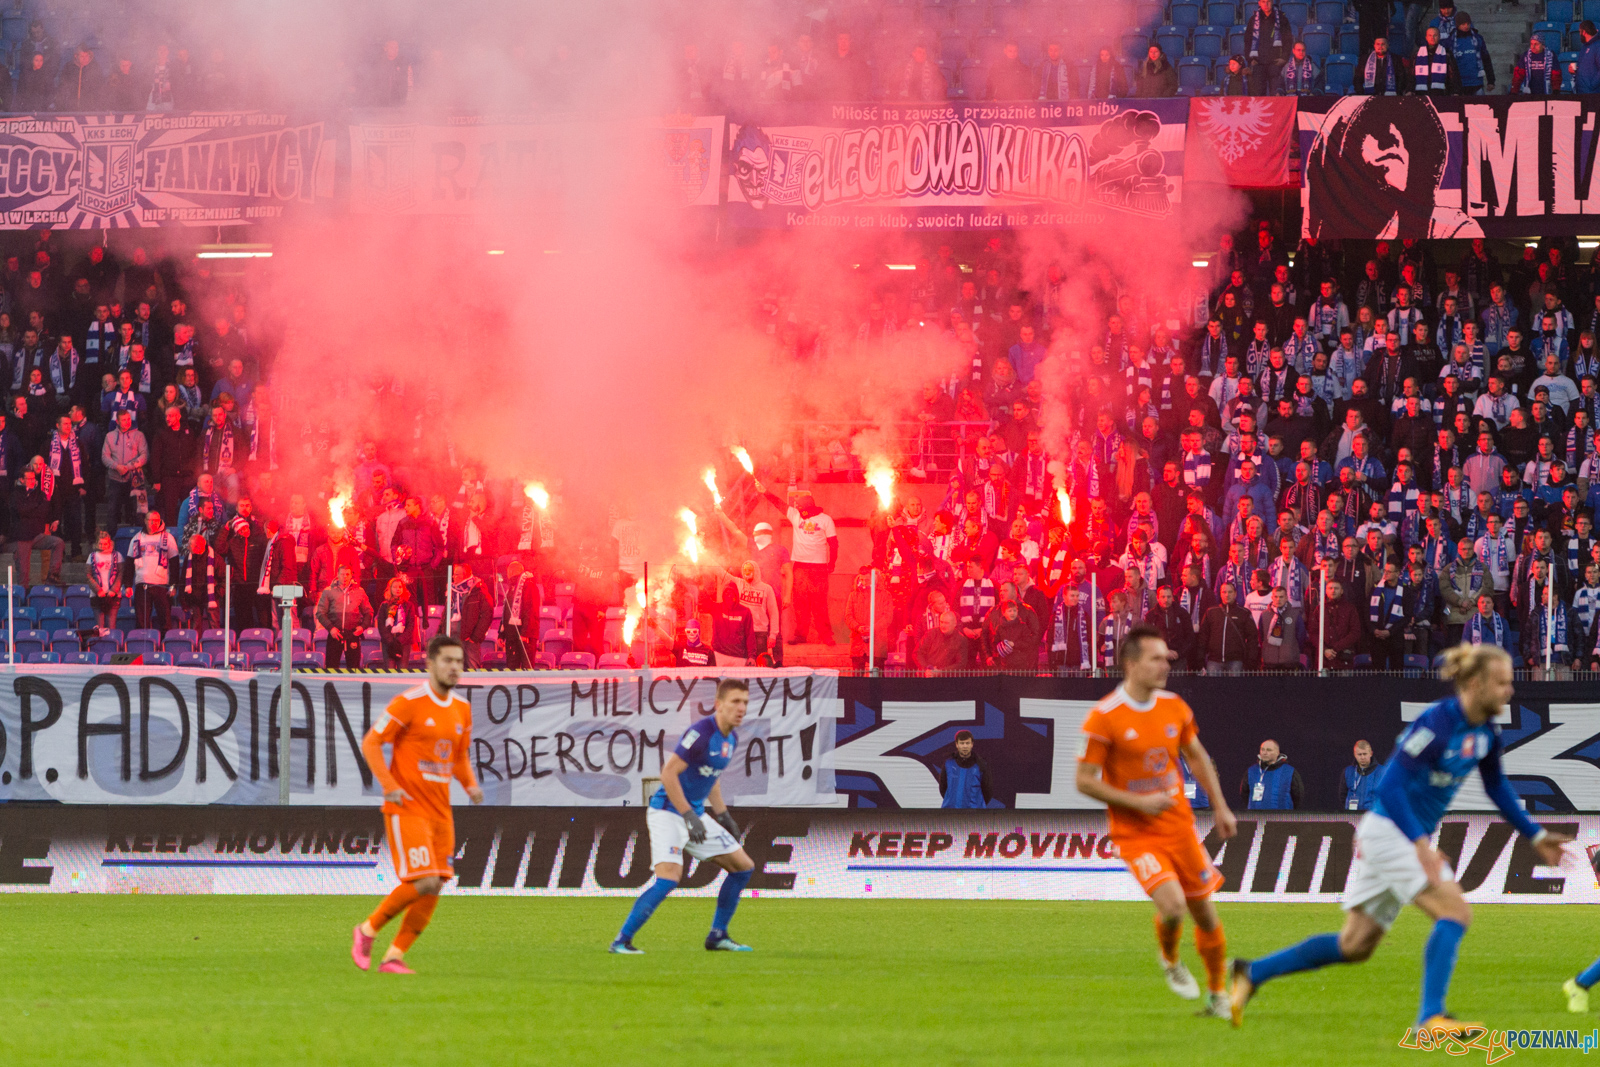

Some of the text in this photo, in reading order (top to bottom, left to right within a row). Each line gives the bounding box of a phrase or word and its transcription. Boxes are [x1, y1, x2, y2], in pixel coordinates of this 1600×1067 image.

[145, 116, 229, 130] POCHODZIMY
[247, 114, 287, 127] WILDY
[832, 105, 878, 120] Miłość
[883, 107, 899, 120] na
[905, 107, 959, 121] zawsze,
[1041, 106, 1061, 119] nie
[1066, 105, 1084, 117] na
[1088, 102, 1119, 116] niby
[10, 121, 74, 133] POZNANIA
[87, 128, 133, 139] KKS LECH
[775, 138, 809, 149] KKS LECH
[145, 124, 324, 202] FANATYCY
[989, 124, 1085, 204] KLIKA
[1465, 101, 1600, 217] MI
[9, 212, 22, 223] W
[25, 211, 67, 223] LECHA
[143, 205, 284, 221] NIE PRZEMINIE NIGDY
[787, 211, 1106, 228] Kochamy ten klub, swoich ludzi nie zdradzimy
[456, 675, 813, 724] TOP MILICYJYM
[0, 672, 375, 788] .P. ADRIAN
[468, 728, 665, 783] RDERCOM
[105, 830, 384, 855] KEEP MOVING!
[848, 831, 956, 858] KEEP
[408, 845, 430, 869] 80
[1133, 852, 1162, 882] 28
